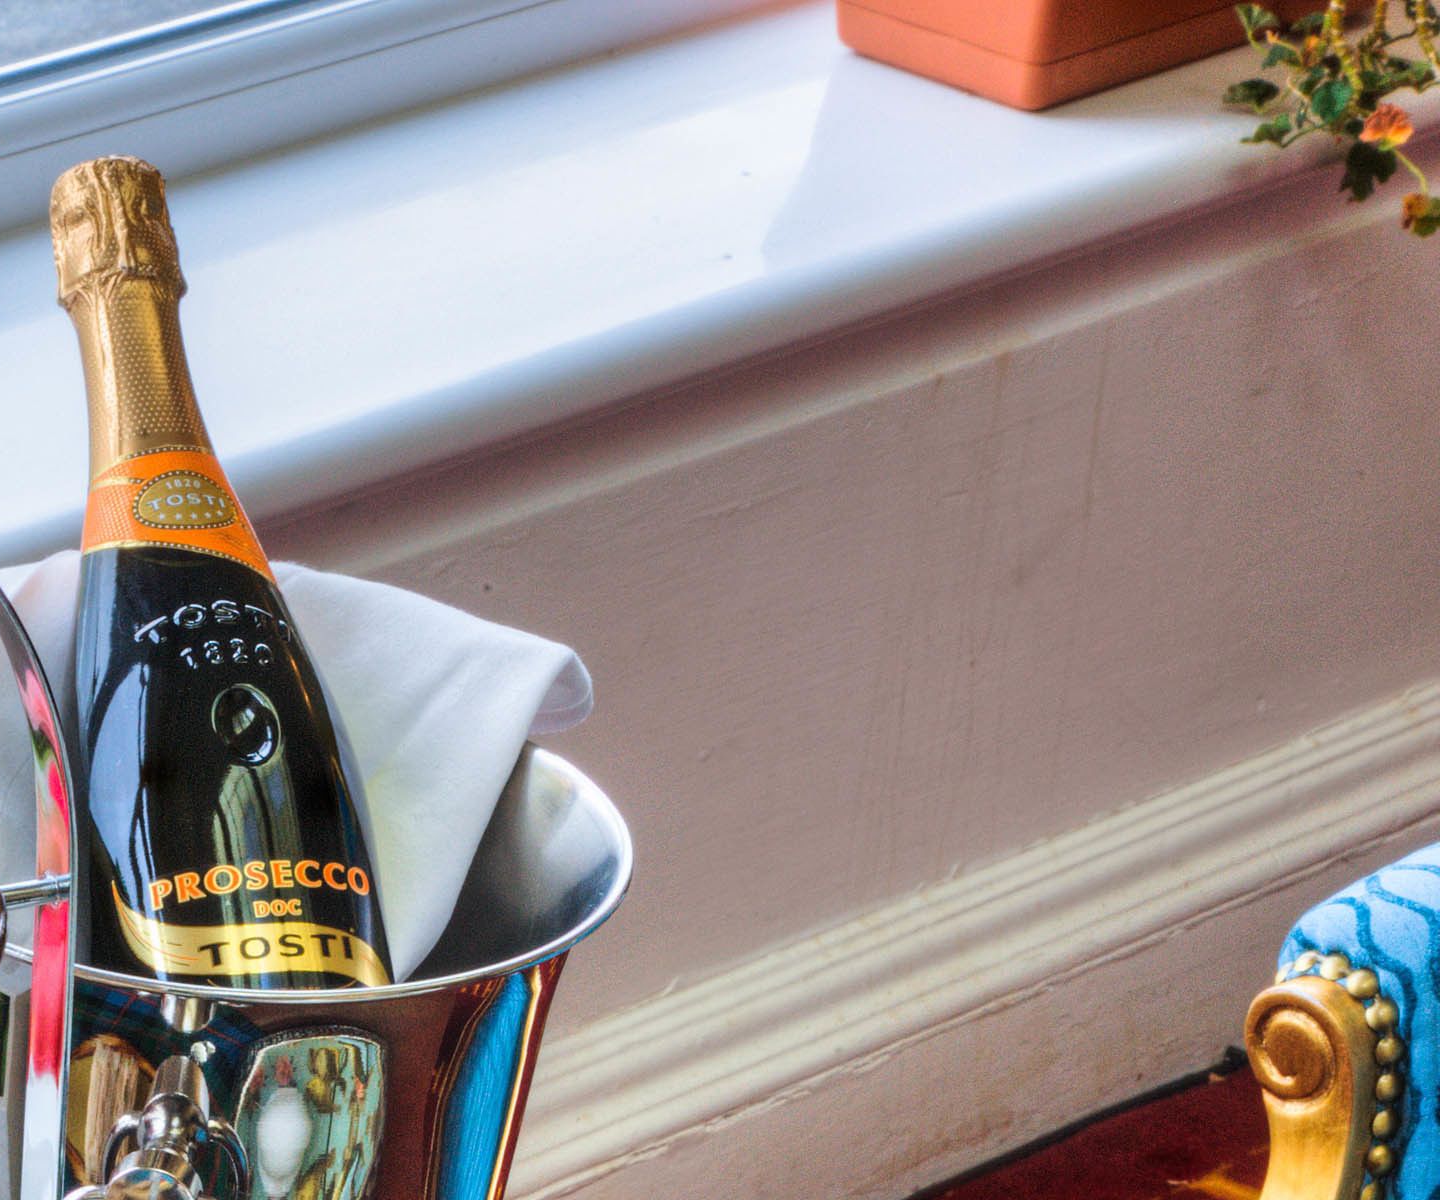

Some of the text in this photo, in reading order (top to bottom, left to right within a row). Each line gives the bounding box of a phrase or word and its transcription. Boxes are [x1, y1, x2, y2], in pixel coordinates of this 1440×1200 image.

[165, 478, 202, 490] 1820
[147, 492, 226, 512] TOSTI
[179, 637, 273, 670] 1820
[148, 859, 371, 911] PROSECCO
[252, 898, 303, 918] DOC
[198, 933, 355, 968] TOSTI
